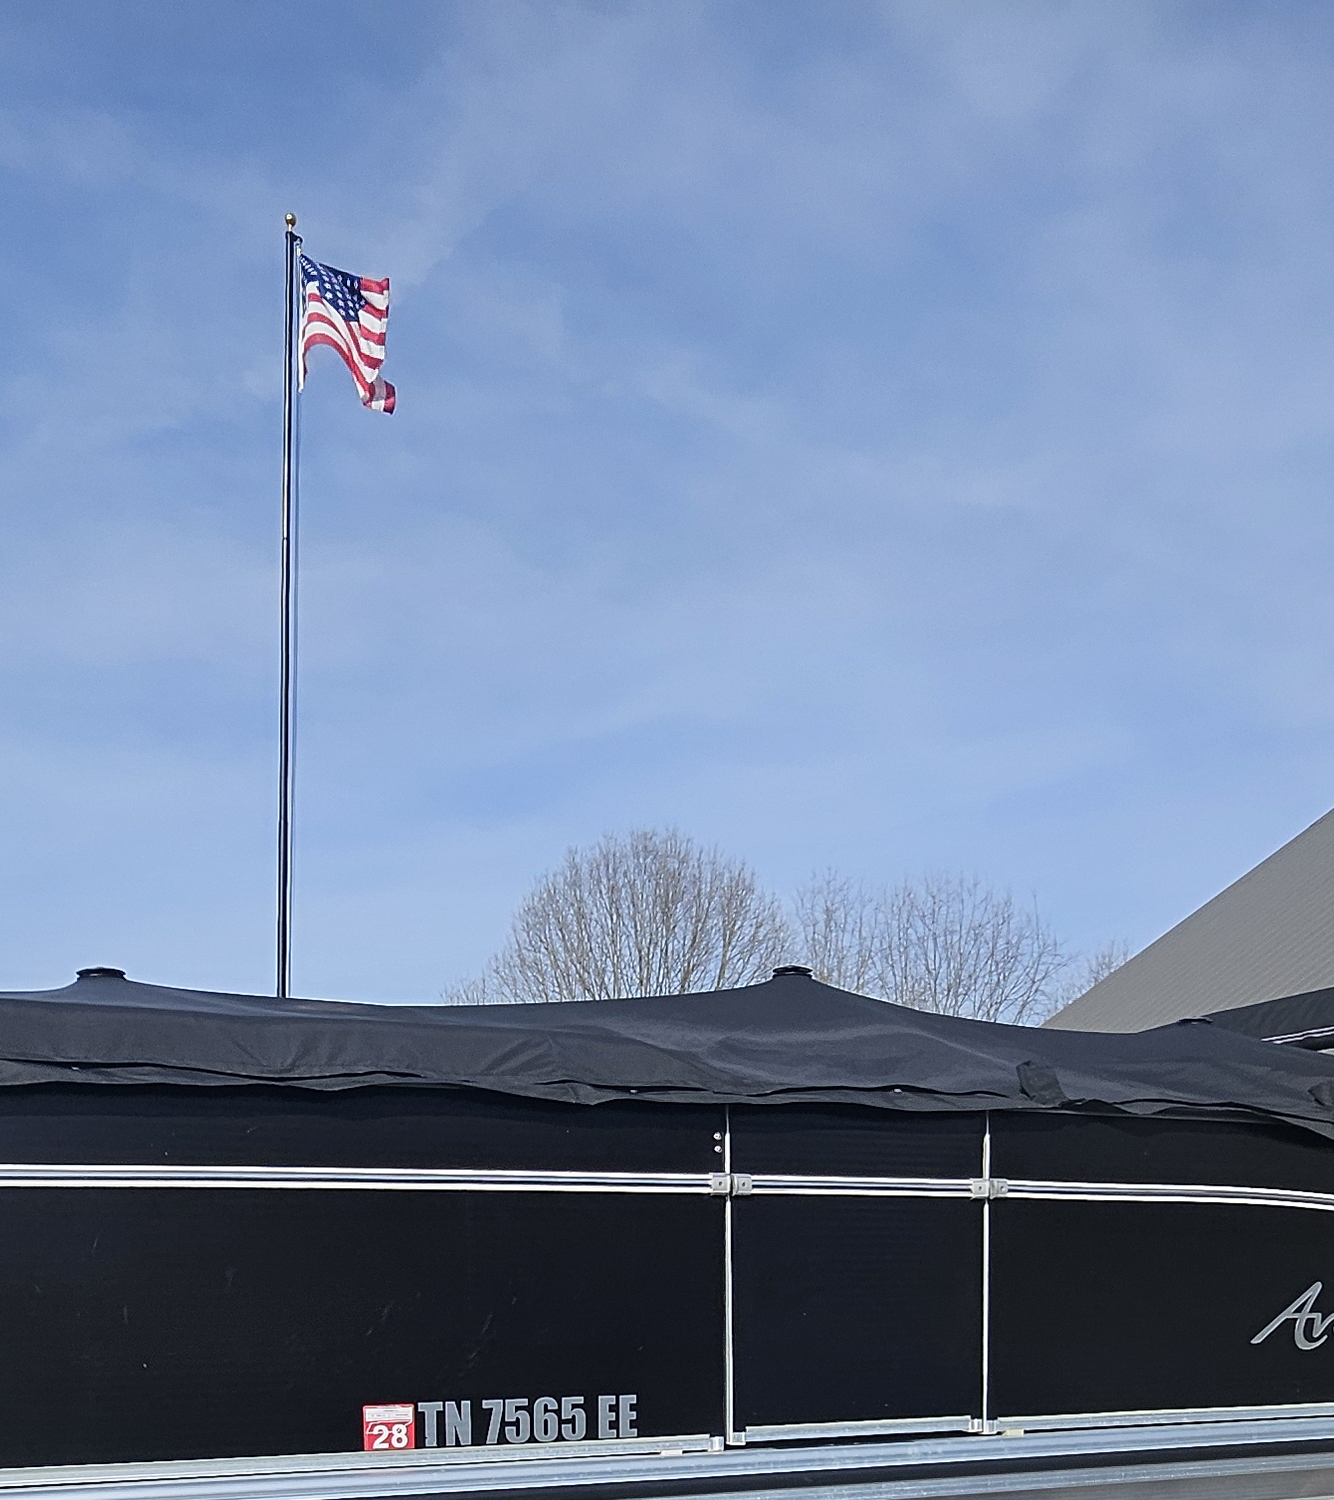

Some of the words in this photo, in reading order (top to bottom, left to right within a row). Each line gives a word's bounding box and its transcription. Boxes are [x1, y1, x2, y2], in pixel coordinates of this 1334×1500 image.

[372, 1424, 409, 1449] 28
[418, 1400, 471, 1446] TN
[482, 1397, 586, 1444] 7565
[598, 1395, 638, 1438] EE
